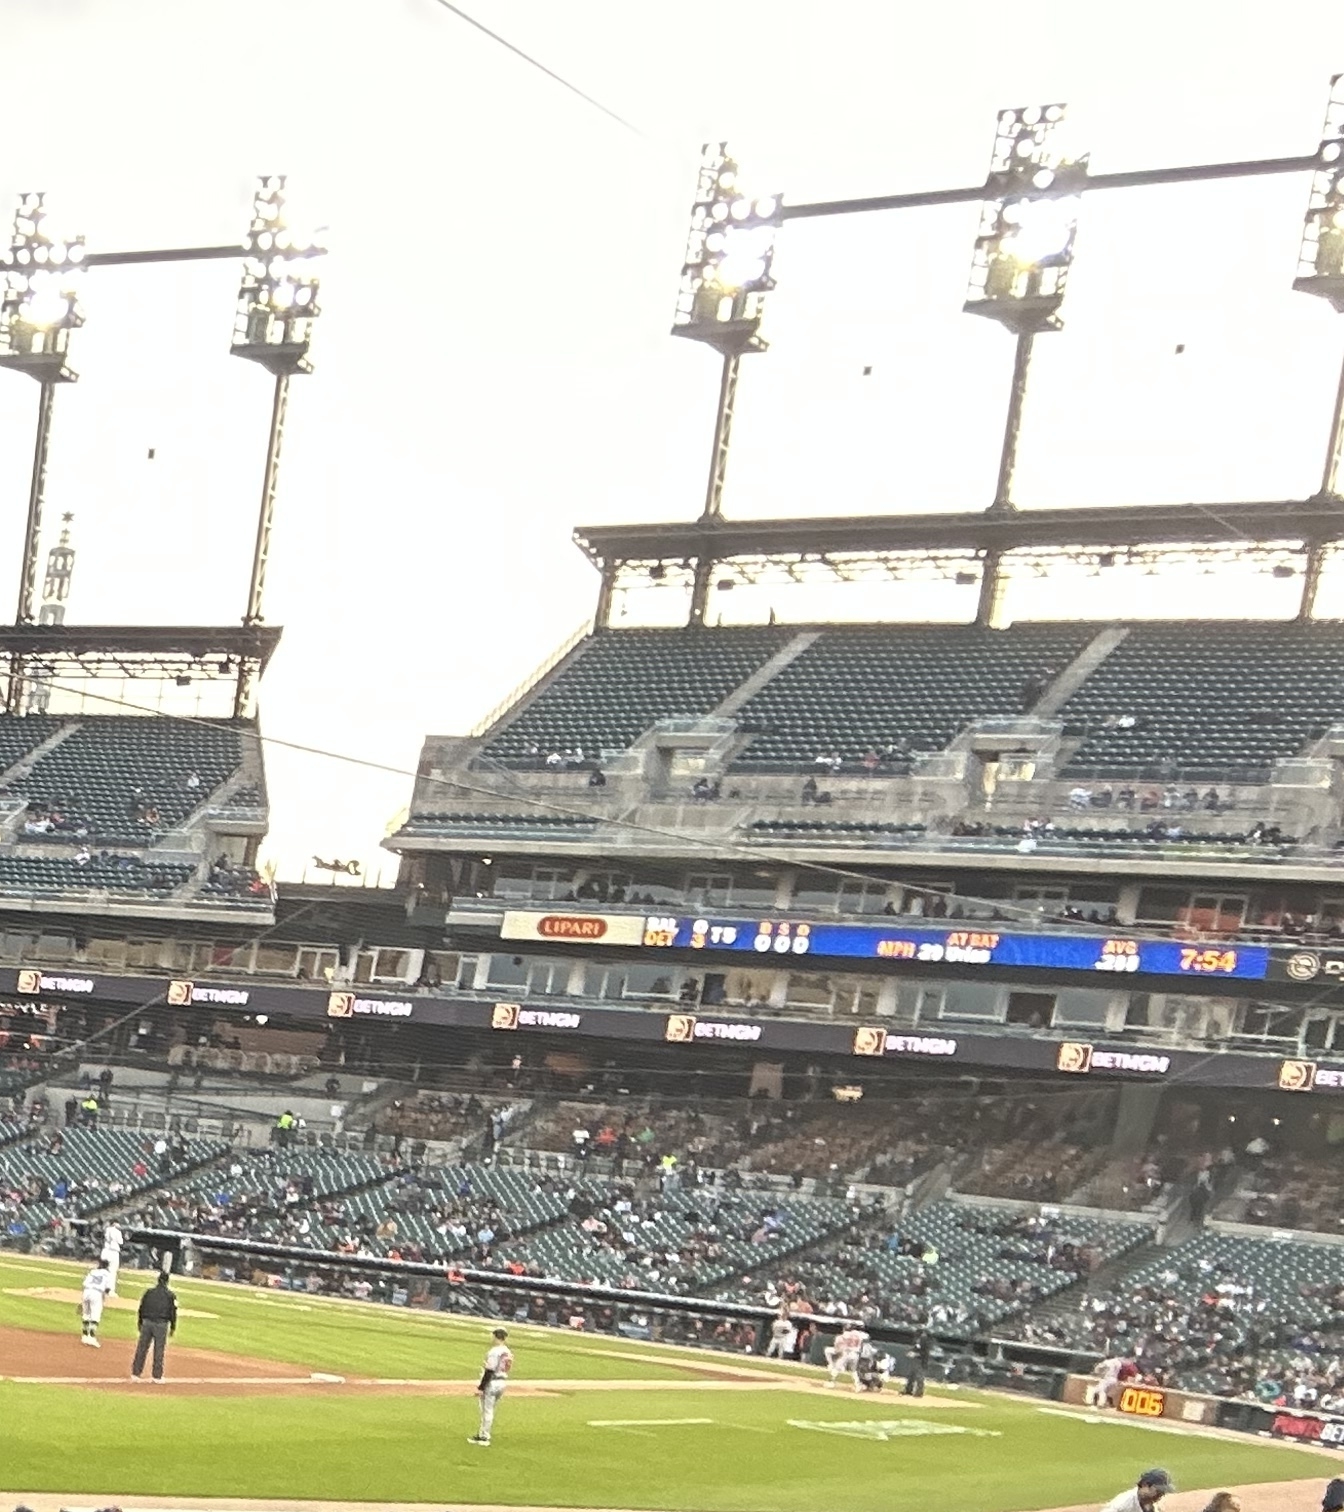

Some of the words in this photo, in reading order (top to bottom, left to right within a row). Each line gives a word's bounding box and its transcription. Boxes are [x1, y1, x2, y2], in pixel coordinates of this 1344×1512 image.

[544, 920, 601, 937] LIPARI
[754, 934, 771, 953] 0
[774, 936, 791, 954] 0
[792, 937, 809, 954] 0
[1180, 949, 1237, 972] 7:54
[1091, 1052, 1171, 1075] BETMGM
[1315, 1070, 1344, 1087] BET
